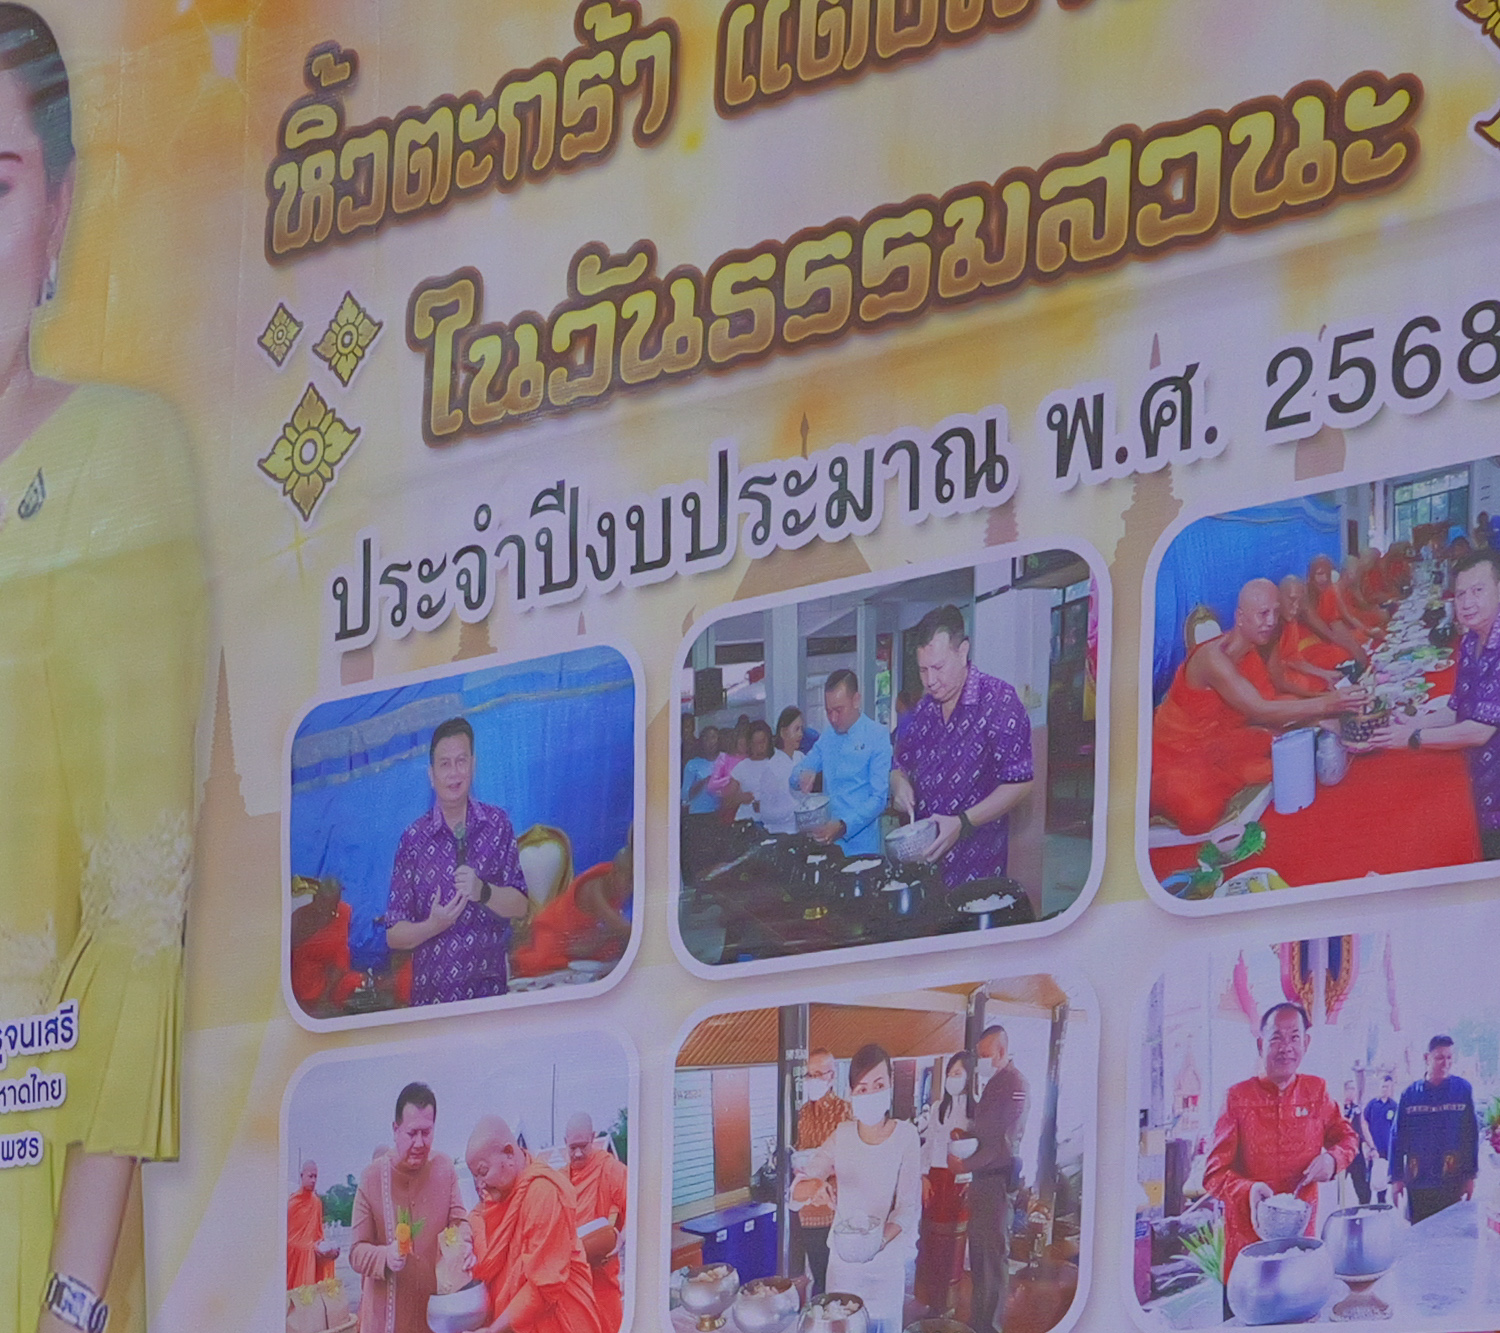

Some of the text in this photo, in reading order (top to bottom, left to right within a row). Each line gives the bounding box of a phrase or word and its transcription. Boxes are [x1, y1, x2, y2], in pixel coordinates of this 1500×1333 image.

[270, 1, 675, 260] หิ้วตะกร้า
[410, 78, 1418, 442] ในวันธรรมสวนะ
[331, 418, 1010, 642] ประจำปีงบประมาณ
[1046, 361, 1218, 479] พ.ศ.
